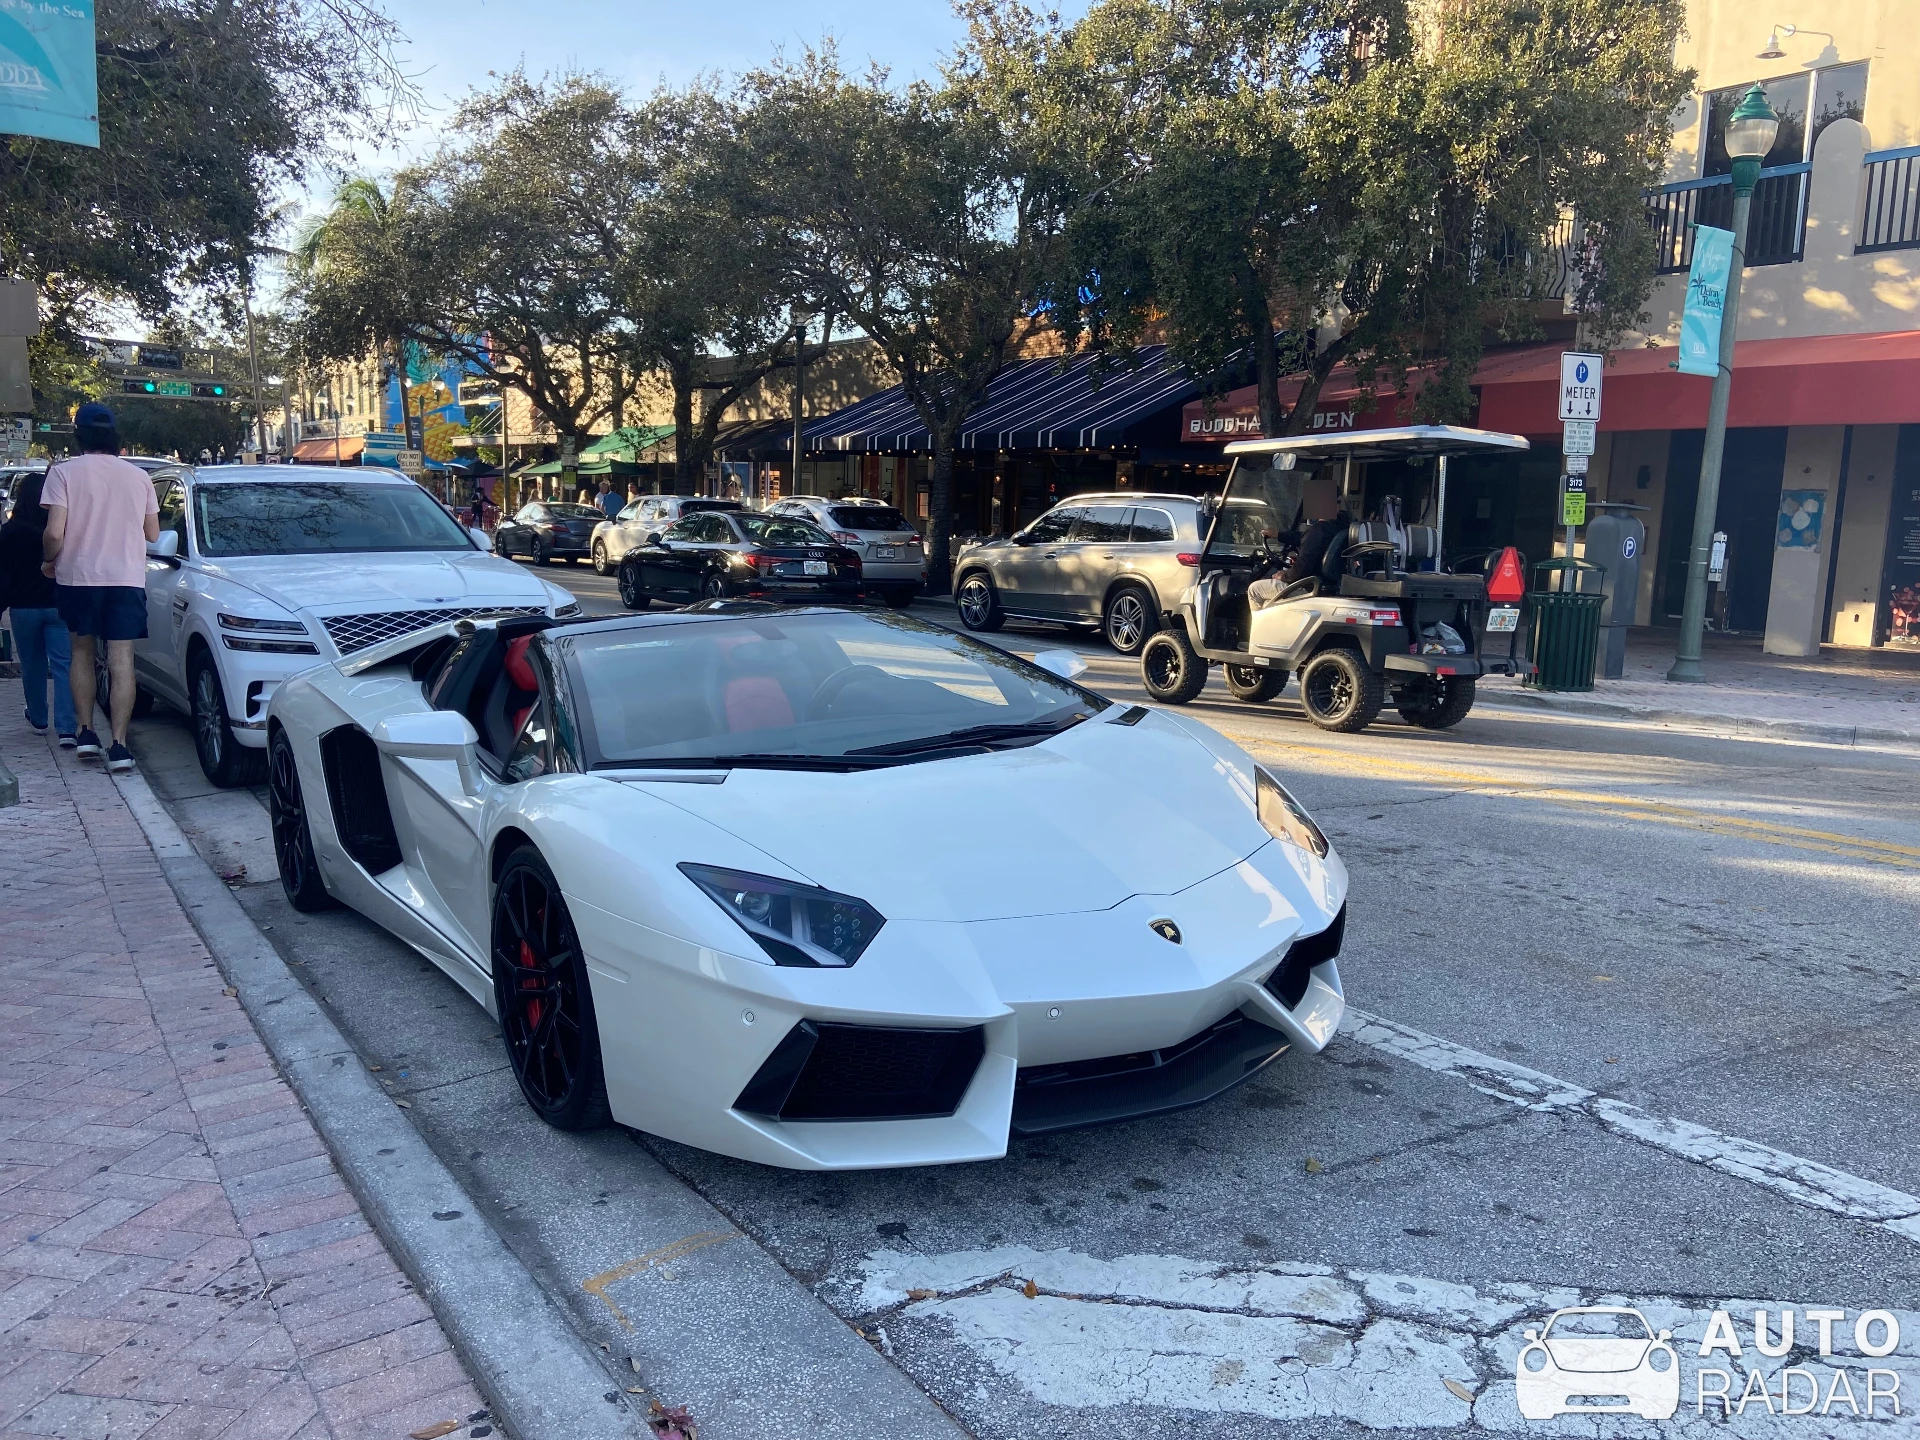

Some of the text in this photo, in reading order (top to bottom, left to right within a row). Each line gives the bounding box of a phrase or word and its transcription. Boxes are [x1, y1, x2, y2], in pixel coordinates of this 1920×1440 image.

[20, 0, 33, 13] by
[40, 2, 60, 15] the
[63, 5, 85, 19] Sea
[1700, 285, 1720, 298] Delray
[1702, 295, 1722, 310] Beach
[1579, 366, 1586, 379] P
[1566, 386, 1596, 400] METER
[1190, 415, 1260, 433] BUDDHA
[1569, 479, 1583, 487] 3173
[1626, 540, 1634, 555] P
[1336, 609, 1369, 618] BEYOND
